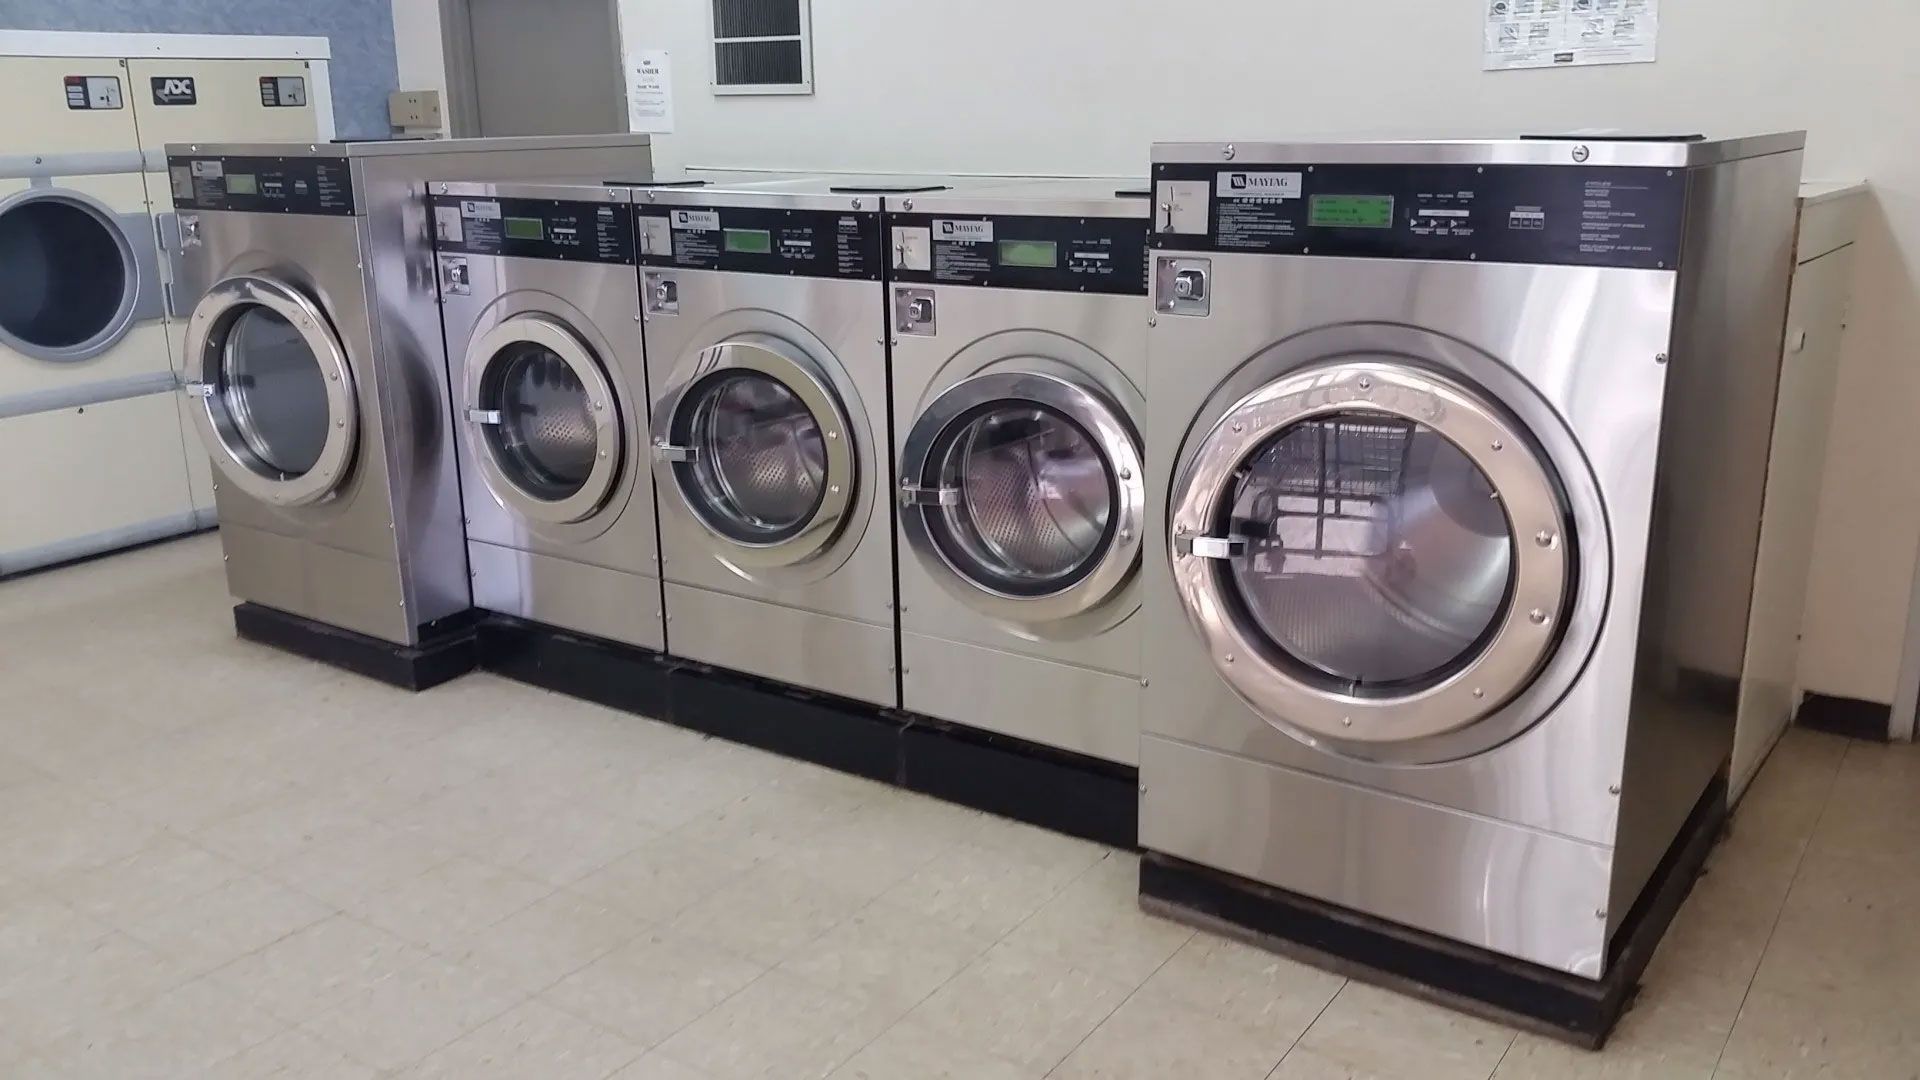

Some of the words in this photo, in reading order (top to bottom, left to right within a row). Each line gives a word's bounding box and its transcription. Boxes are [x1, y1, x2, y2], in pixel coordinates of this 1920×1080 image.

[164, 79, 192, 95] ADC
[1249, 177, 1288, 187] MAYTAG
[955, 224, 984, 233] MAYTAG
